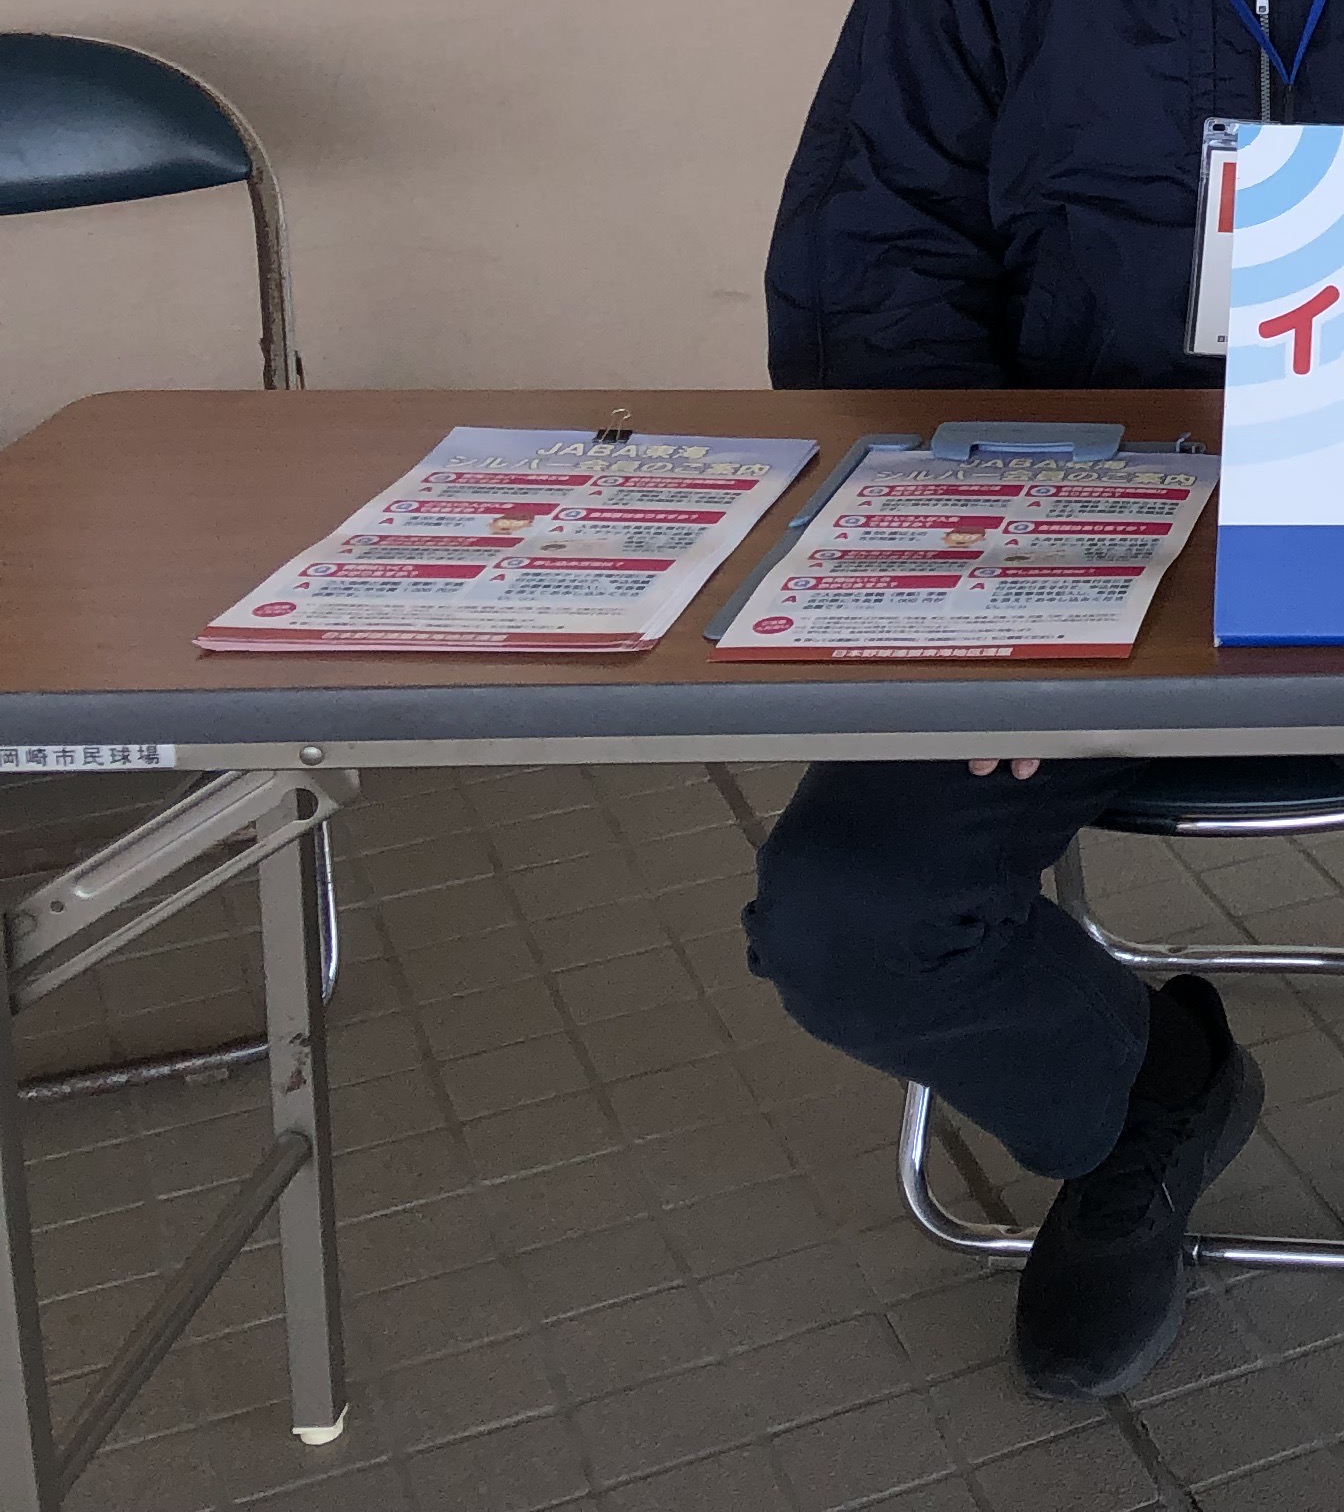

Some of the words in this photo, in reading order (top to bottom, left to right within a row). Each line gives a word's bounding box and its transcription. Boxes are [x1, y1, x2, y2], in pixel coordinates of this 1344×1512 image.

[0, 745, 161, 768] 岡崎市民球場
